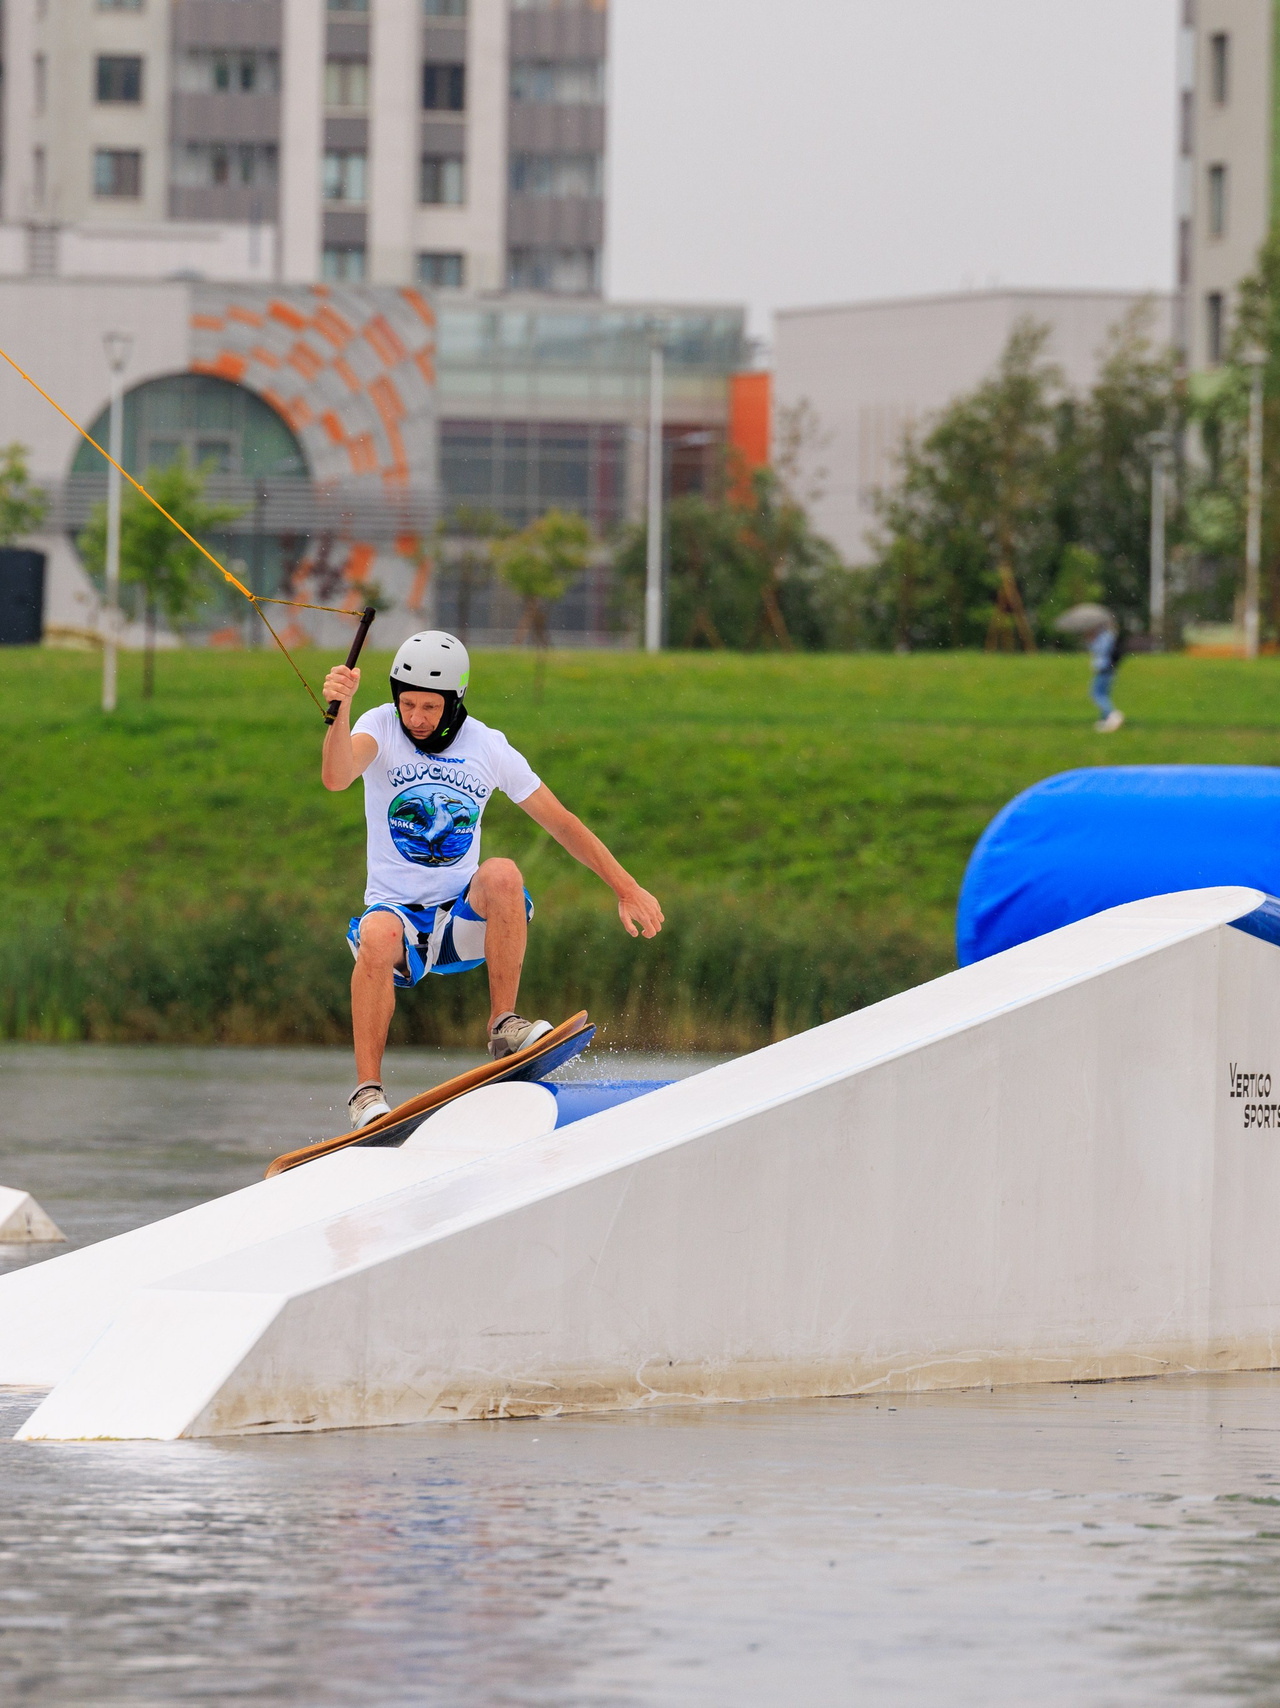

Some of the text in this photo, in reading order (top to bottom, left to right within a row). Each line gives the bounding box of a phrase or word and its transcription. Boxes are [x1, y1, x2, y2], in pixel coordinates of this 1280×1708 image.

[387, 762, 489, 798] KUPCHINO
[389, 818, 414, 830] WAKE
[1229, 1062, 1272, 1098] VERTIGO
